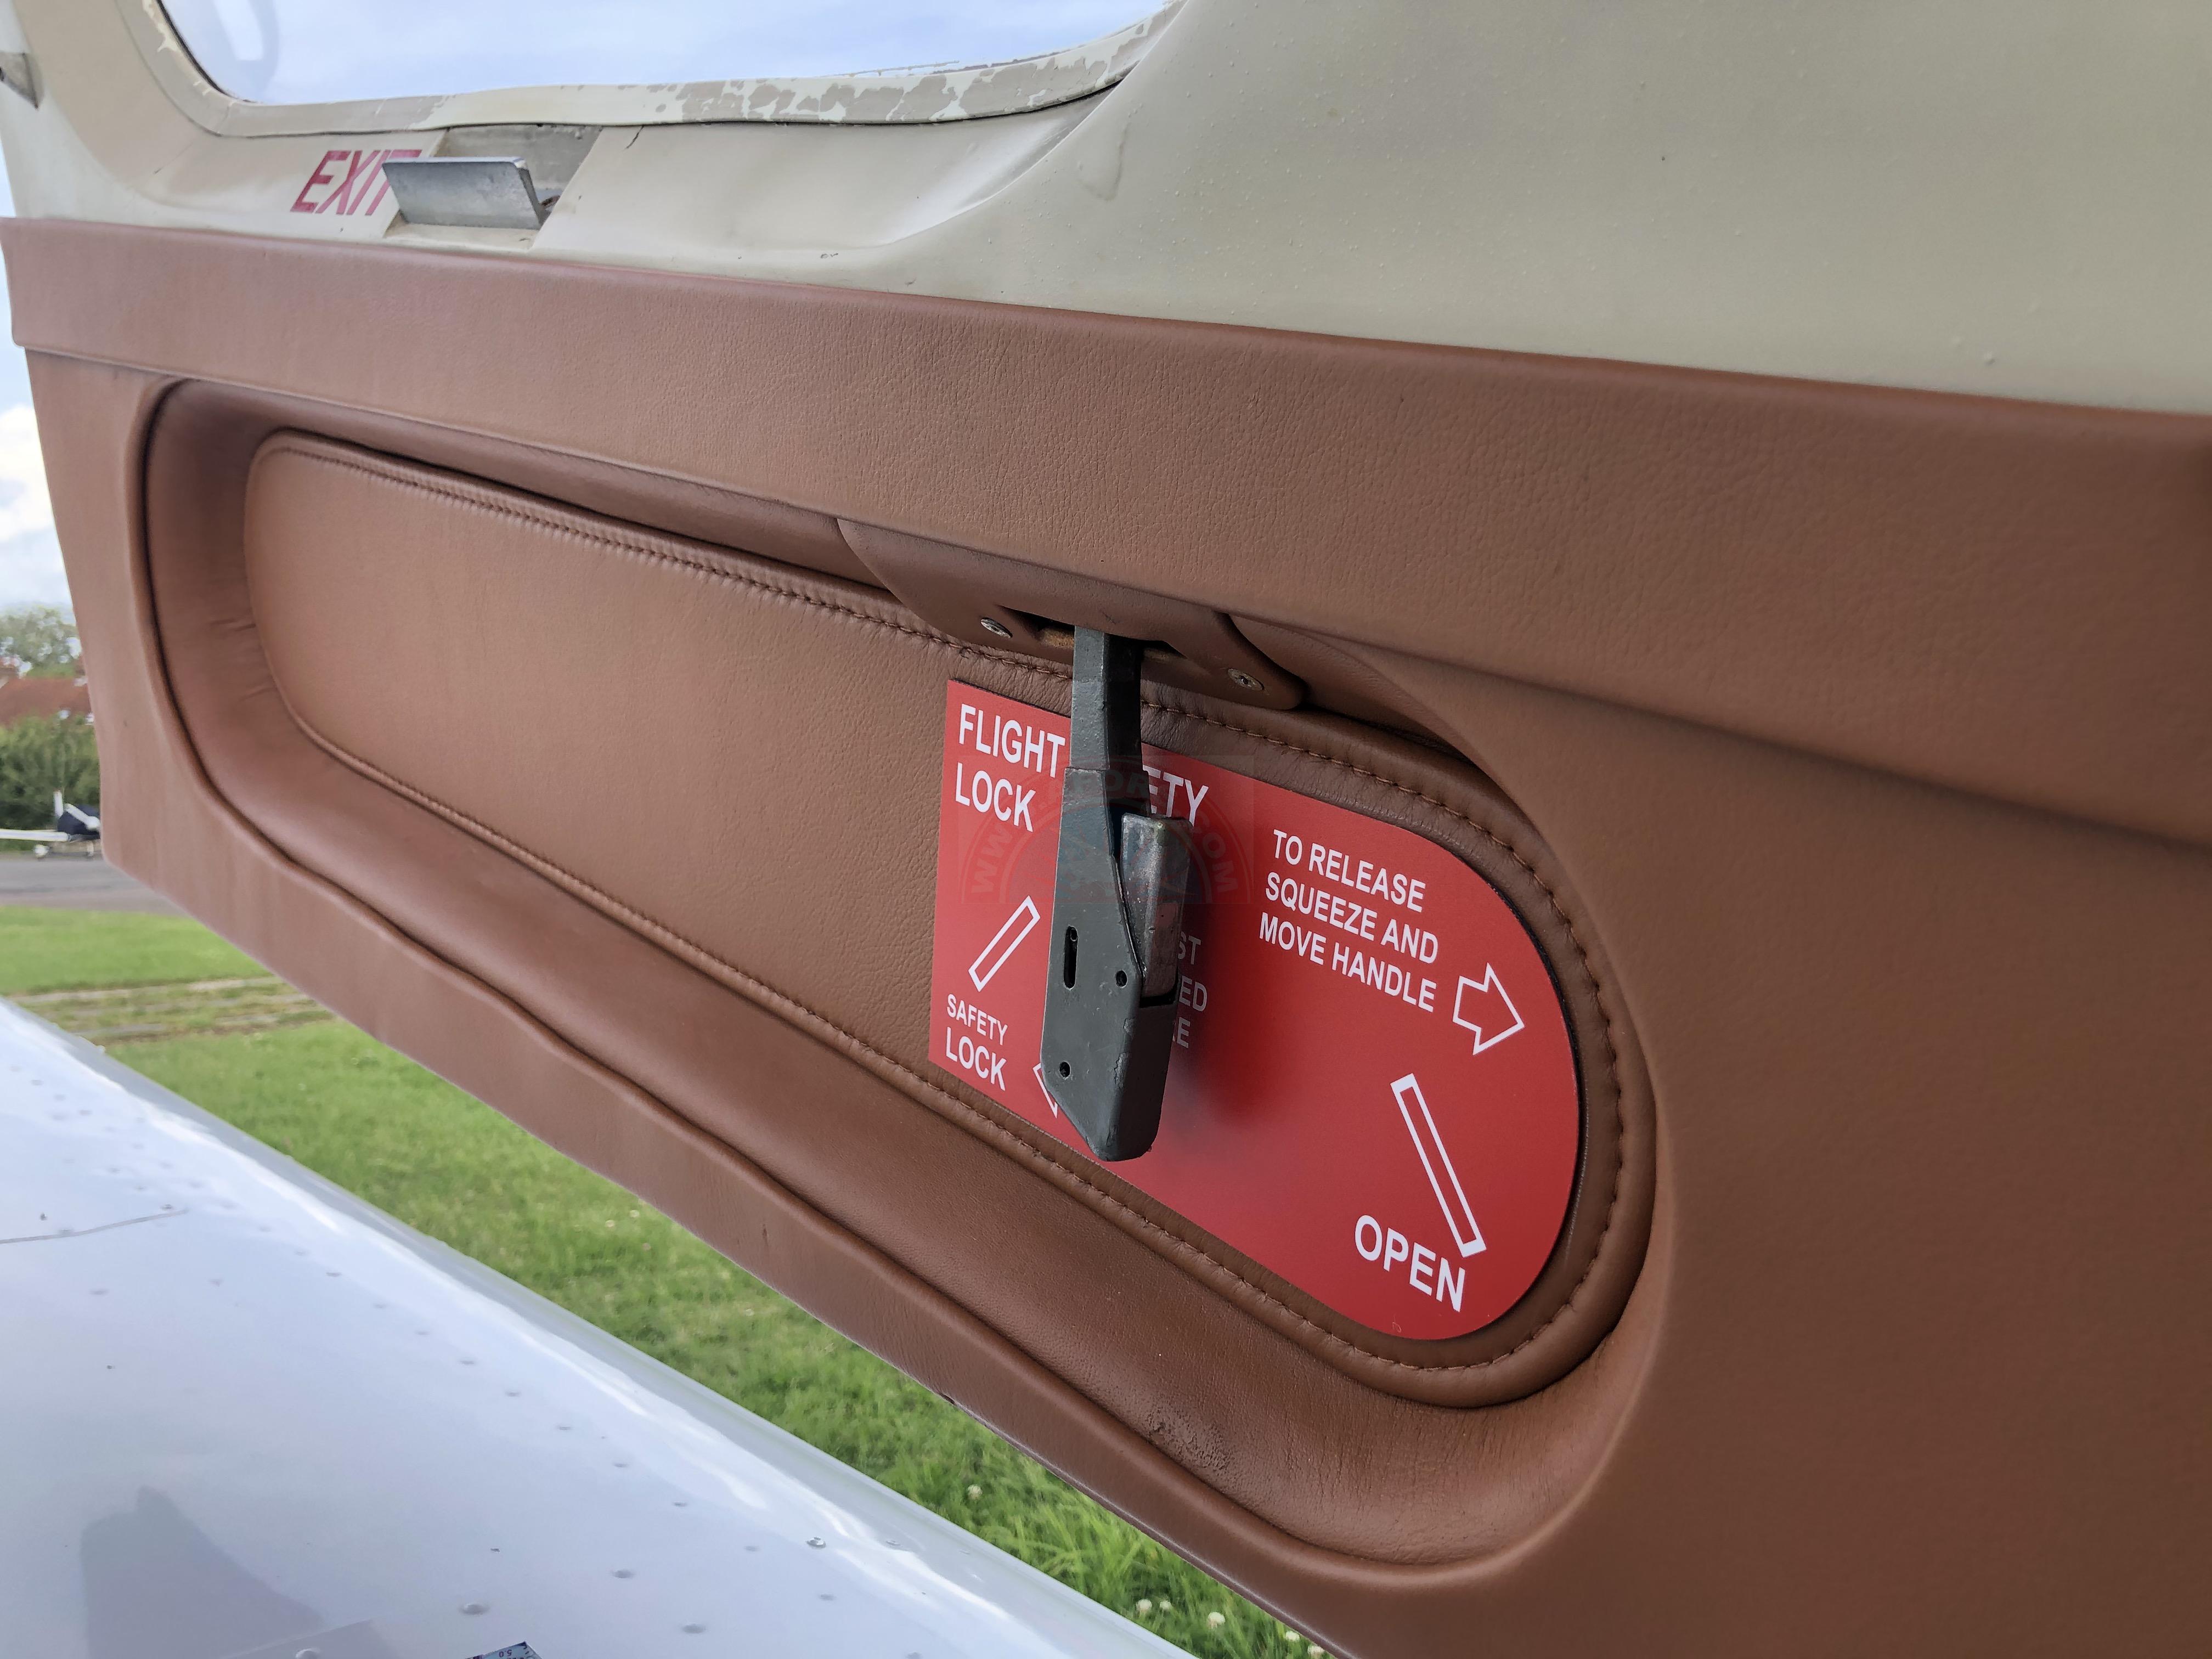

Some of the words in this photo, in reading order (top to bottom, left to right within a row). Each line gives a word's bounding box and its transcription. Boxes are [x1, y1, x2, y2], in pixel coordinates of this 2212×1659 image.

[290, 149, 422, 216] EXIT
[955, 762, 1036, 832] LOCK
[960, 703, 1065, 778] FLIGHT
[1143, 766, 1209, 826] ETY
[1273, 829, 1302, 865] TO
[1308, 843, 1426, 913] RELEASE
[1265, 872, 1378, 941] SQUEEZE
[1380, 919, 1438, 964] AND
[1259, 912, 1327, 965] MOVE
[1331, 943, 1436, 1013] HANDLE
[946, 1027, 1007, 1091] LOCK
[947, 994, 1008, 1045] SAFETY
[1355, 1215, 1465, 1312] OPEN
